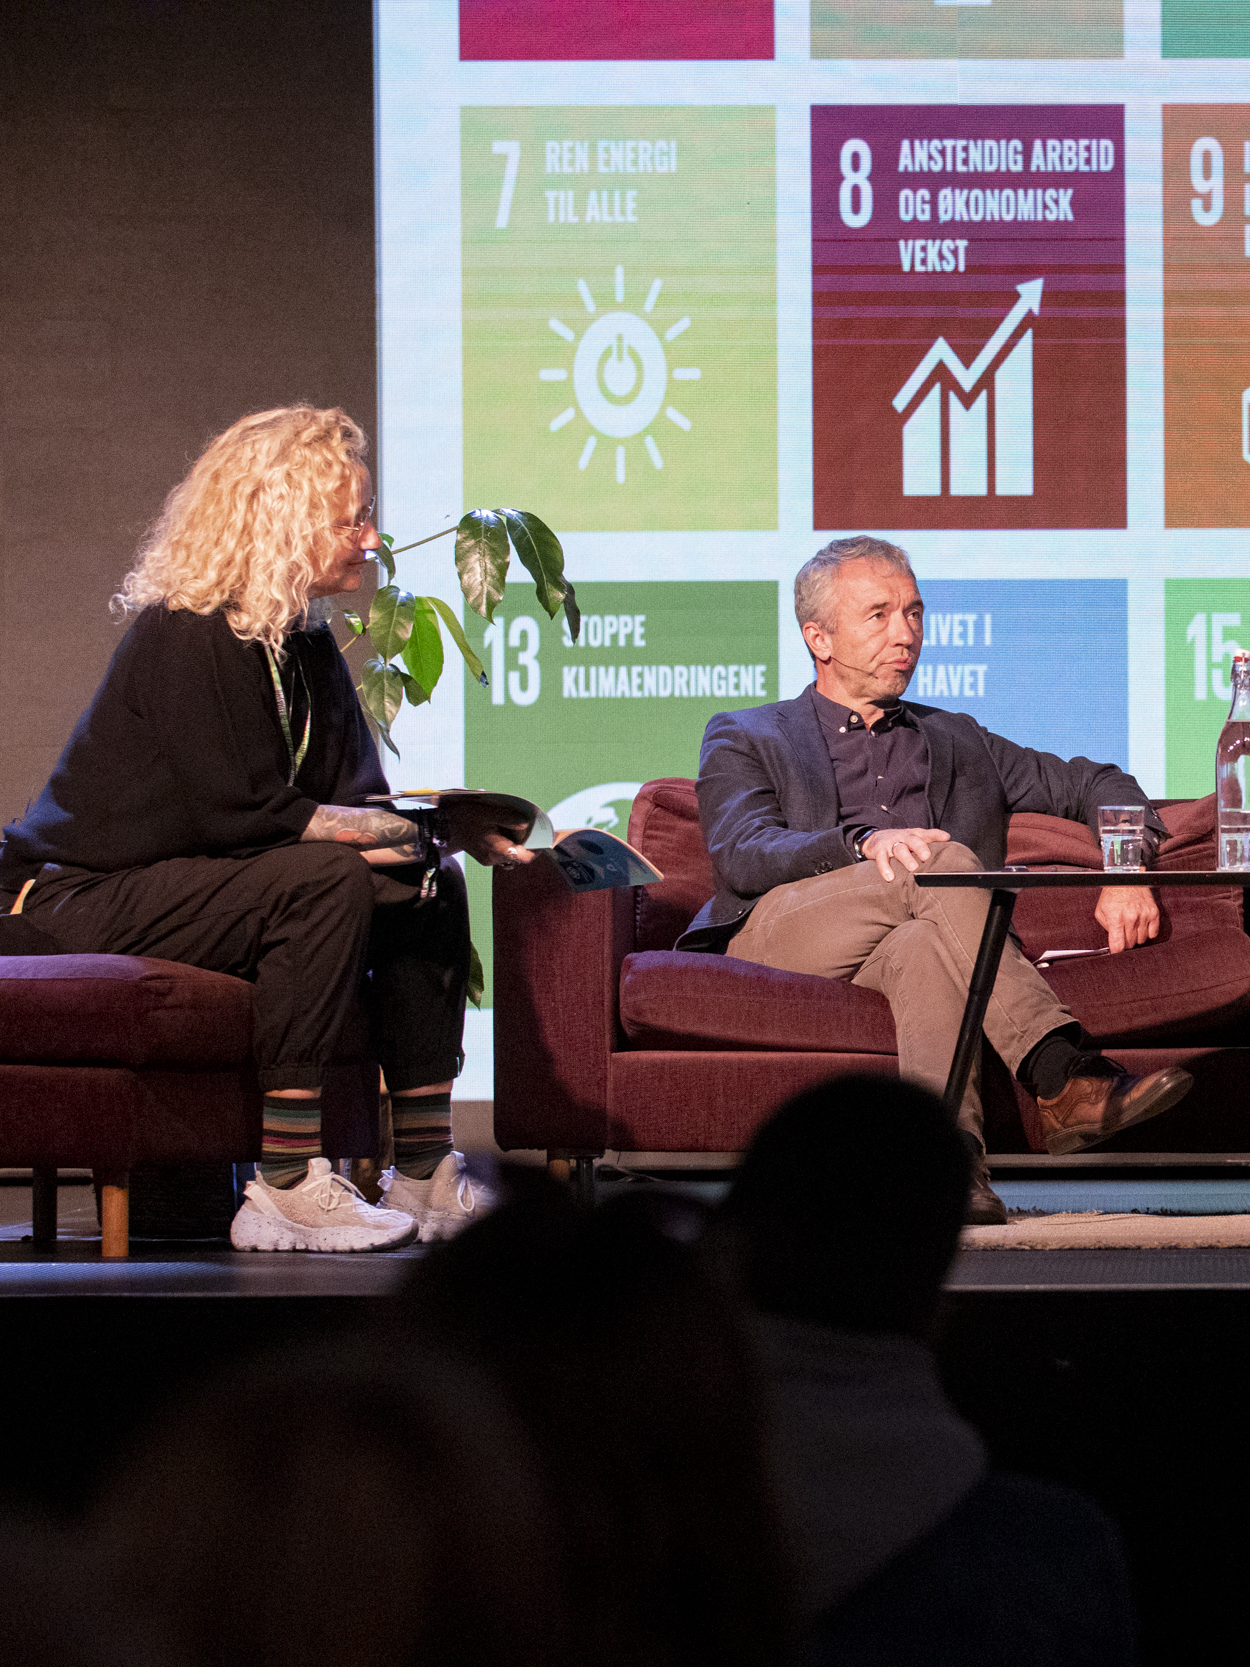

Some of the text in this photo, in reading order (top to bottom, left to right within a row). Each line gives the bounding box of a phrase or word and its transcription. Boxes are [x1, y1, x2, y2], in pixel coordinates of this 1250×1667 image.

[545, 140, 677, 173] REN ENERGI
[898, 139, 1114, 172] ANSTENDIG ARBEID
[492, 140, 521, 228] 7
[838, 139, 873, 228] 8
[1190, 137, 1224, 226] 9
[545, 190, 638, 223] TIL ALLE
[898, 187, 1074, 223] OG ØKONOMISK
[898, 239, 968, 272] VEKST
[922, 613, 992, 646] IVET I
[484, 615, 541, 706] 13
[1186, 612, 1241, 700] 15
[563, 664, 767, 699] KLIMAENDRINGENE
[917, 664, 988, 697] HAVET
